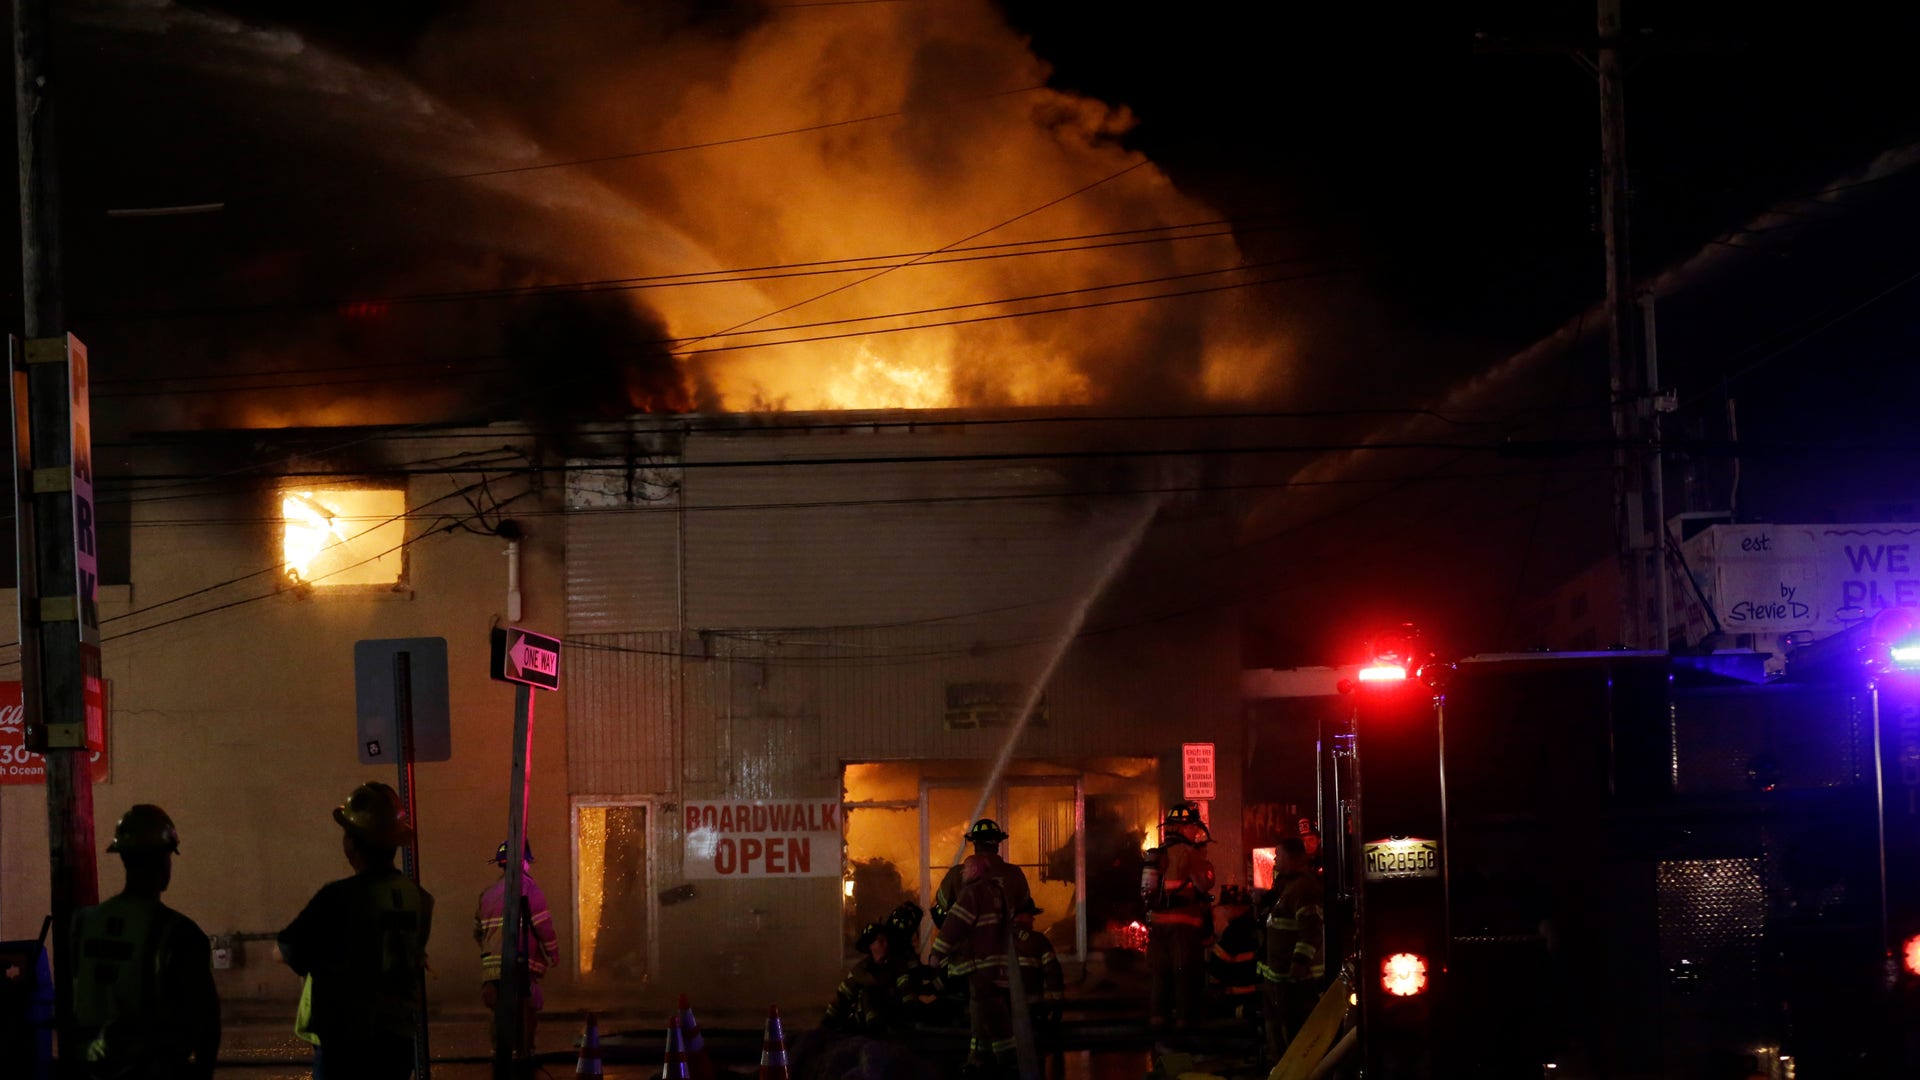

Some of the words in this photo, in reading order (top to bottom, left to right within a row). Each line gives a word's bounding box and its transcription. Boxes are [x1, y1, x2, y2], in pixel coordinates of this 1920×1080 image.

[73, 348, 98, 631] PARK
[1741, 533, 1772, 551] est.
[1844, 544, 1910, 573] WE
[1780, 582, 1796, 602] by
[1729, 601, 1786, 621] Stevie
[1788, 602, 1810, 619] D.
[523, 647, 539, 669] ONE
[540, 650, 556, 673] WAY
[9, 766, 44, 775] Ocean
[685, 803, 837, 834] BOARDWALK
[715, 838, 810, 875] OPEN
